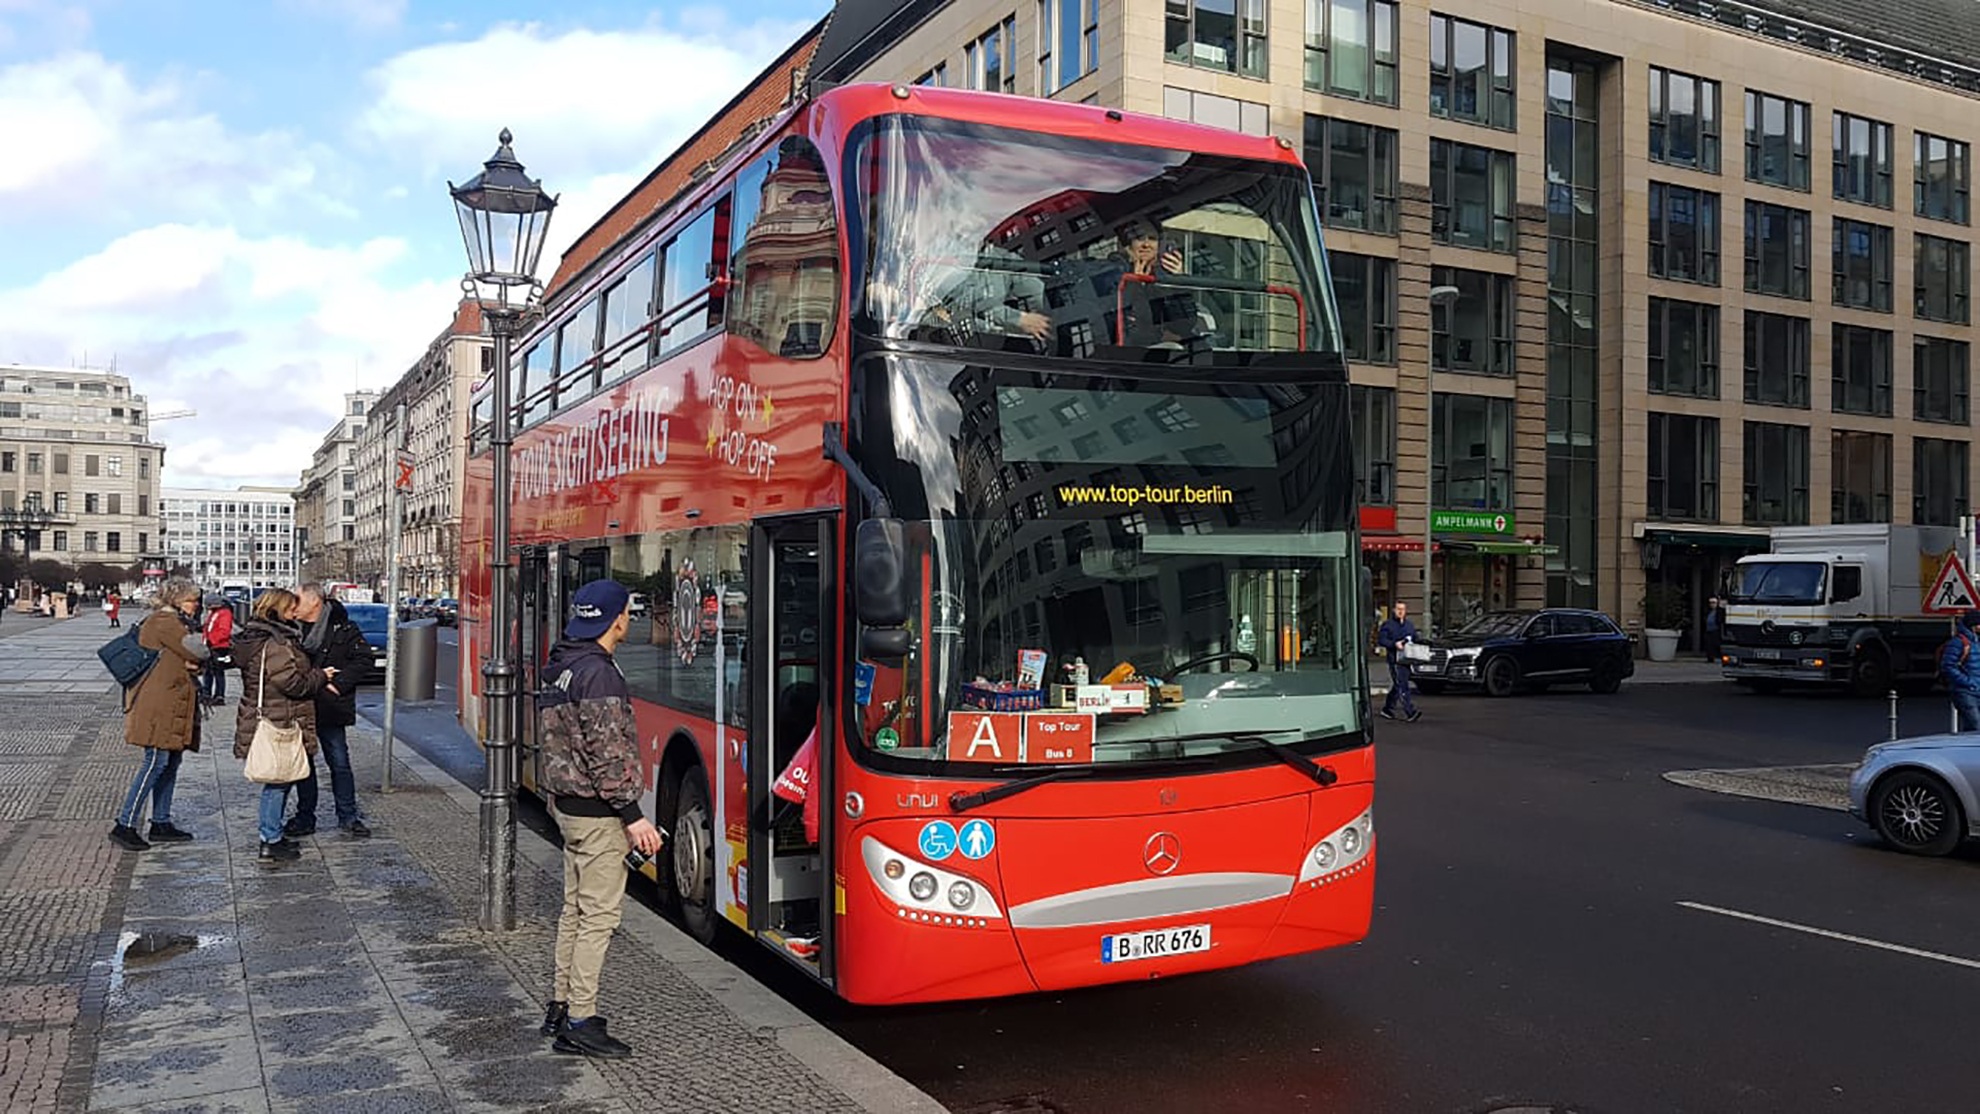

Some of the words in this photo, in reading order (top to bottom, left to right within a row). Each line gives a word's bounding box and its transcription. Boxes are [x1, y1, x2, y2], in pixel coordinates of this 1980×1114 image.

[708, 375, 734, 411] HOP
[735, 382, 757, 421] ON
[519, 438, 551, 502] TOUR
[553, 386, 669, 493] SIGHTSEEING
[718, 427, 746, 467] HOP
[747, 438, 777, 483] OFF
[1059, 484, 1233, 507] www.top-tour.berlin
[1435, 515, 1493, 529] AMPELMANN
[966, 716, 1002, 758] A
[1038, 721, 1057, 734] Top
[1059, 721, 1081, 732] Tour
[1045, 748, 1065, 759] Bus
[1119, 938, 1131, 958] B
[1143, 932, 1167, 955] RR
[1171, 928, 1203, 951] 676
